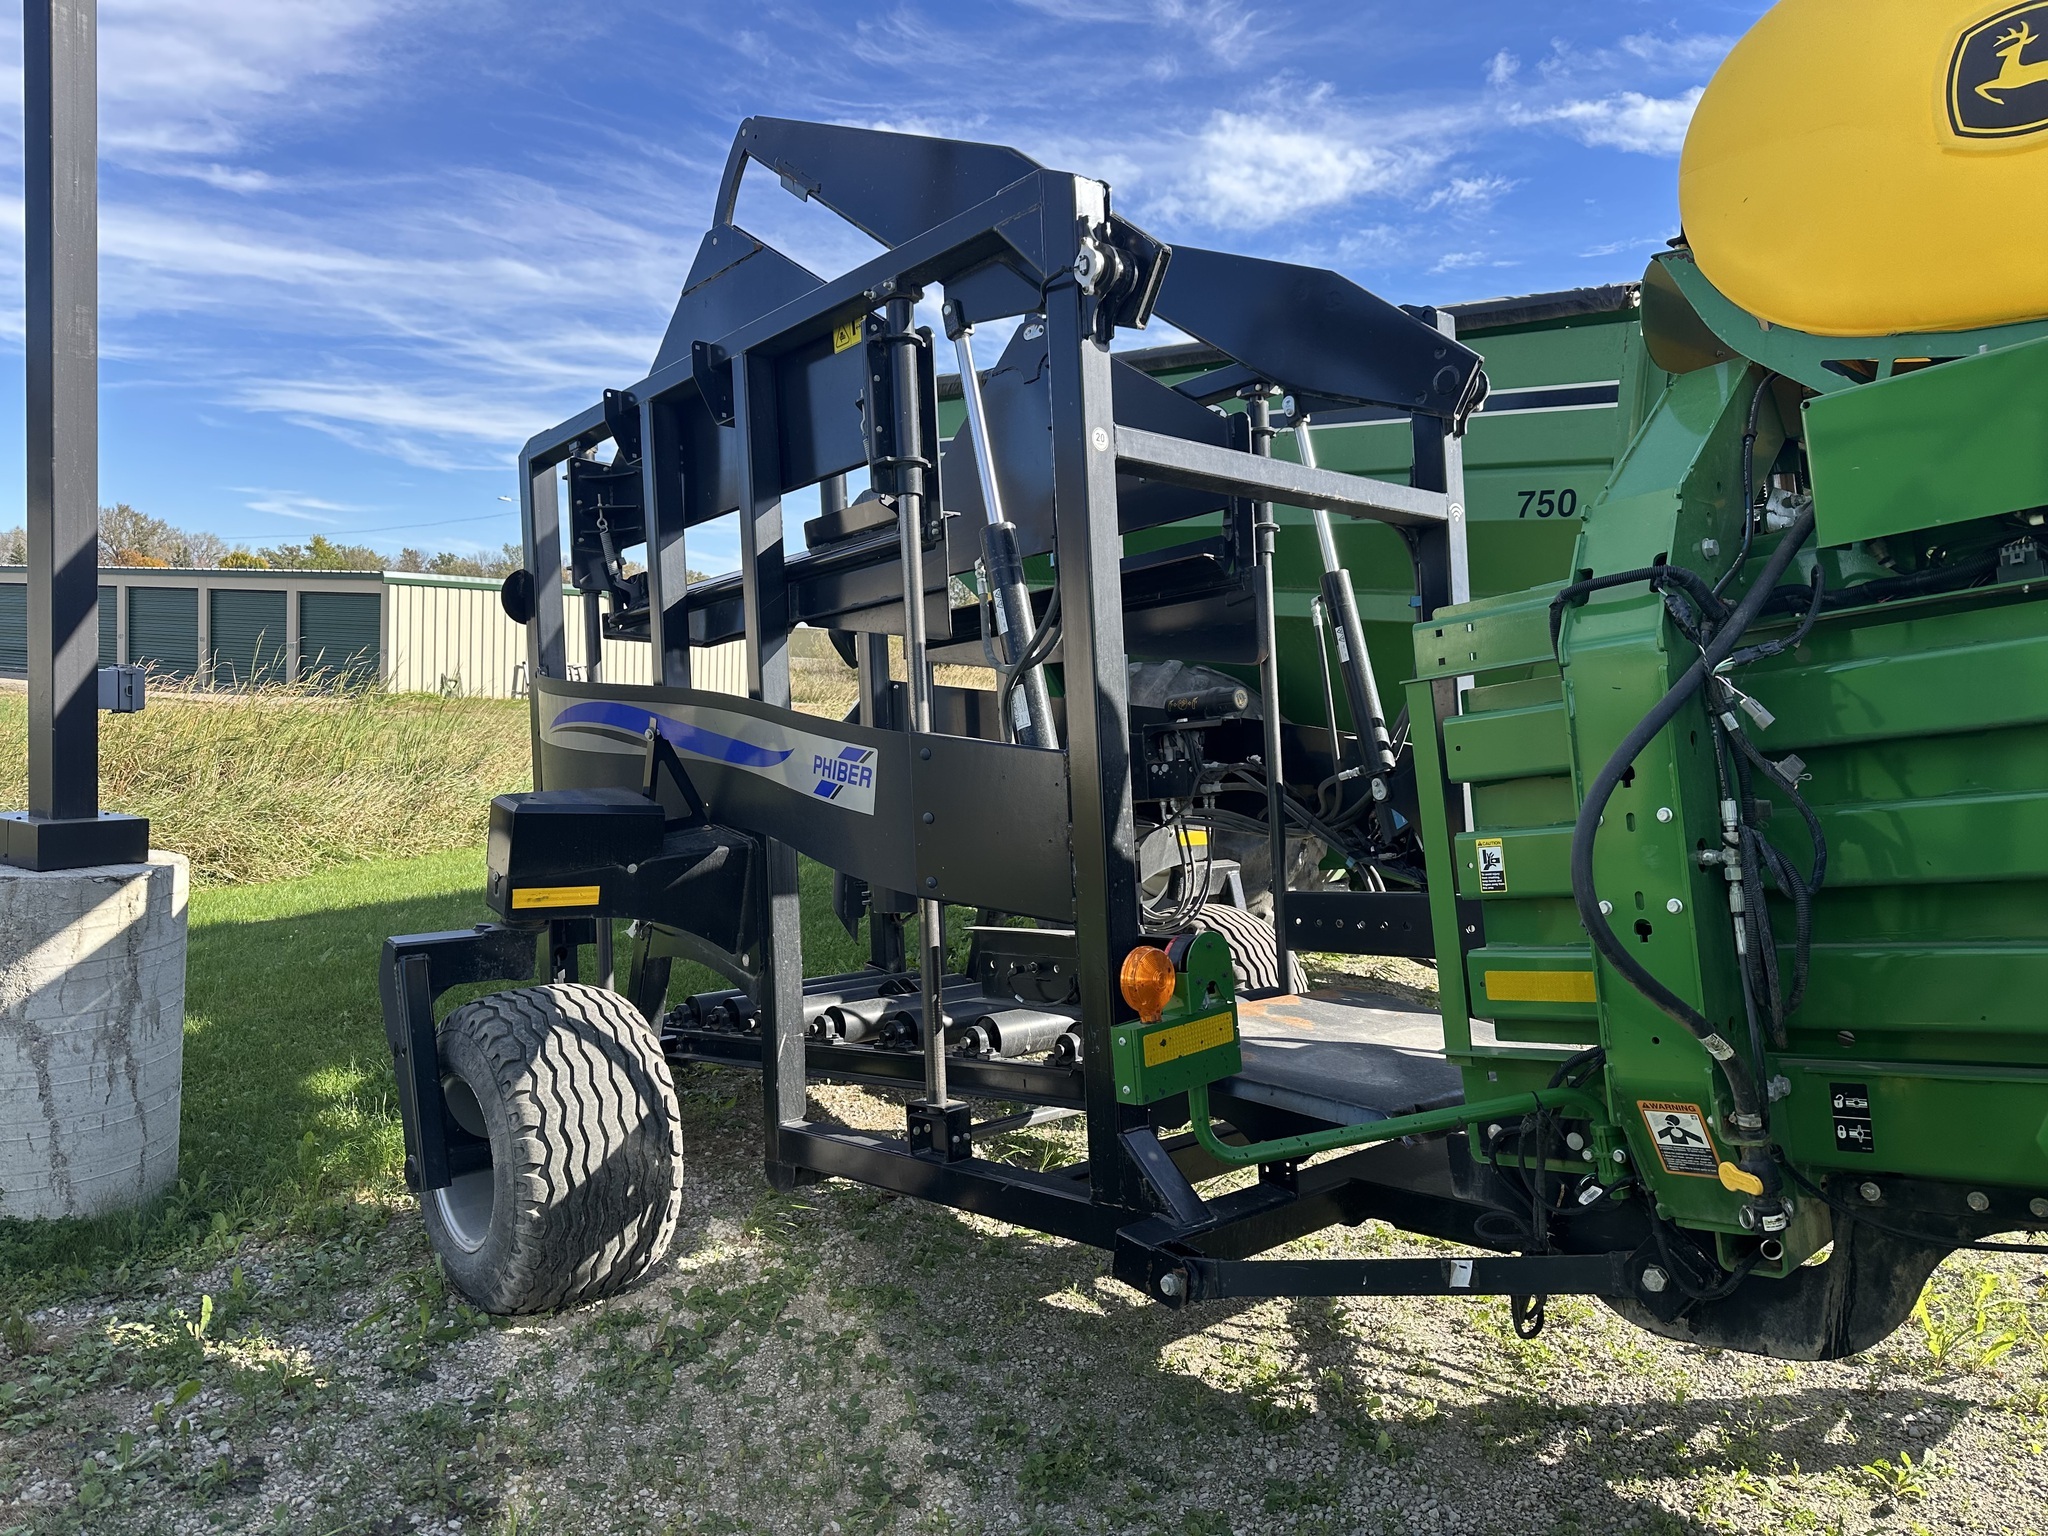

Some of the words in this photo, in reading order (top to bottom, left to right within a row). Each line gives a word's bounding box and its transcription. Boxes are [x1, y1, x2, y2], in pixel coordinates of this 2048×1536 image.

[1517, 488, 1577, 518] 750
[813, 754, 873, 788] PHIBER
[1649, 1103, 1697, 1112] WARNING
